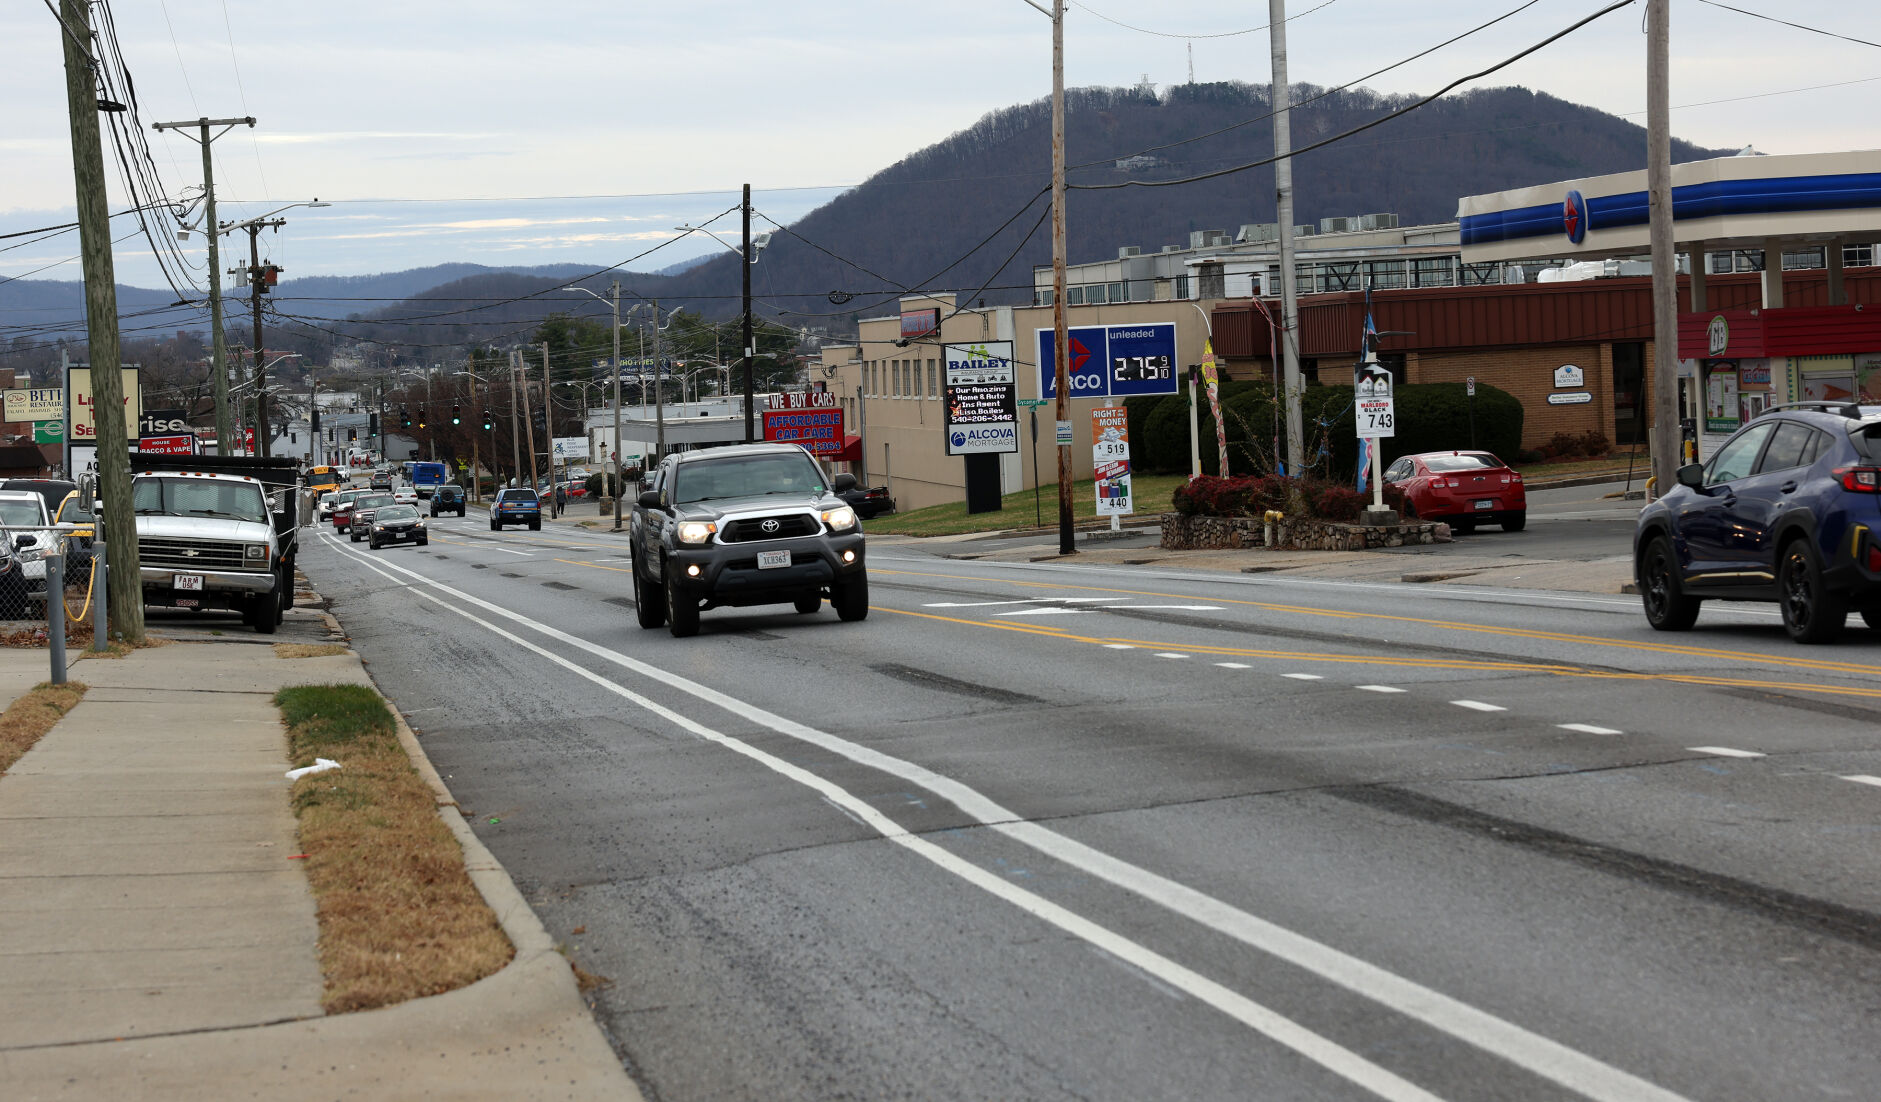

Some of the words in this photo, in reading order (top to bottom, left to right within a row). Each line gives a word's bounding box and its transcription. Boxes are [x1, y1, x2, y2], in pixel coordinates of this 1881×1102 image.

[1110, 329, 1155, 340] unleaded
[948, 359, 1008, 370] BAILEY
[1115, 356, 1158, 380] 2.75
[1161, 356, 1168, 366] 9
[1161, 369, 1169, 379] 10
[771, 394, 785, 408] WE
[790, 393, 806, 408] BUY
[812, 392, 833, 407] CARS
[976, 400, 1000, 408] Agent
[952, 414, 1012, 423] 540-206-3442
[1093, 410, 1117, 418] RIGHT
[768, 413, 840, 428] AFFORDABLE
[1100, 418, 1126, 426] MONEY
[776, 429, 799, 440] CAR
[804, 427, 833, 438] CARE
[968, 429, 1014, 439] ALCOVA
